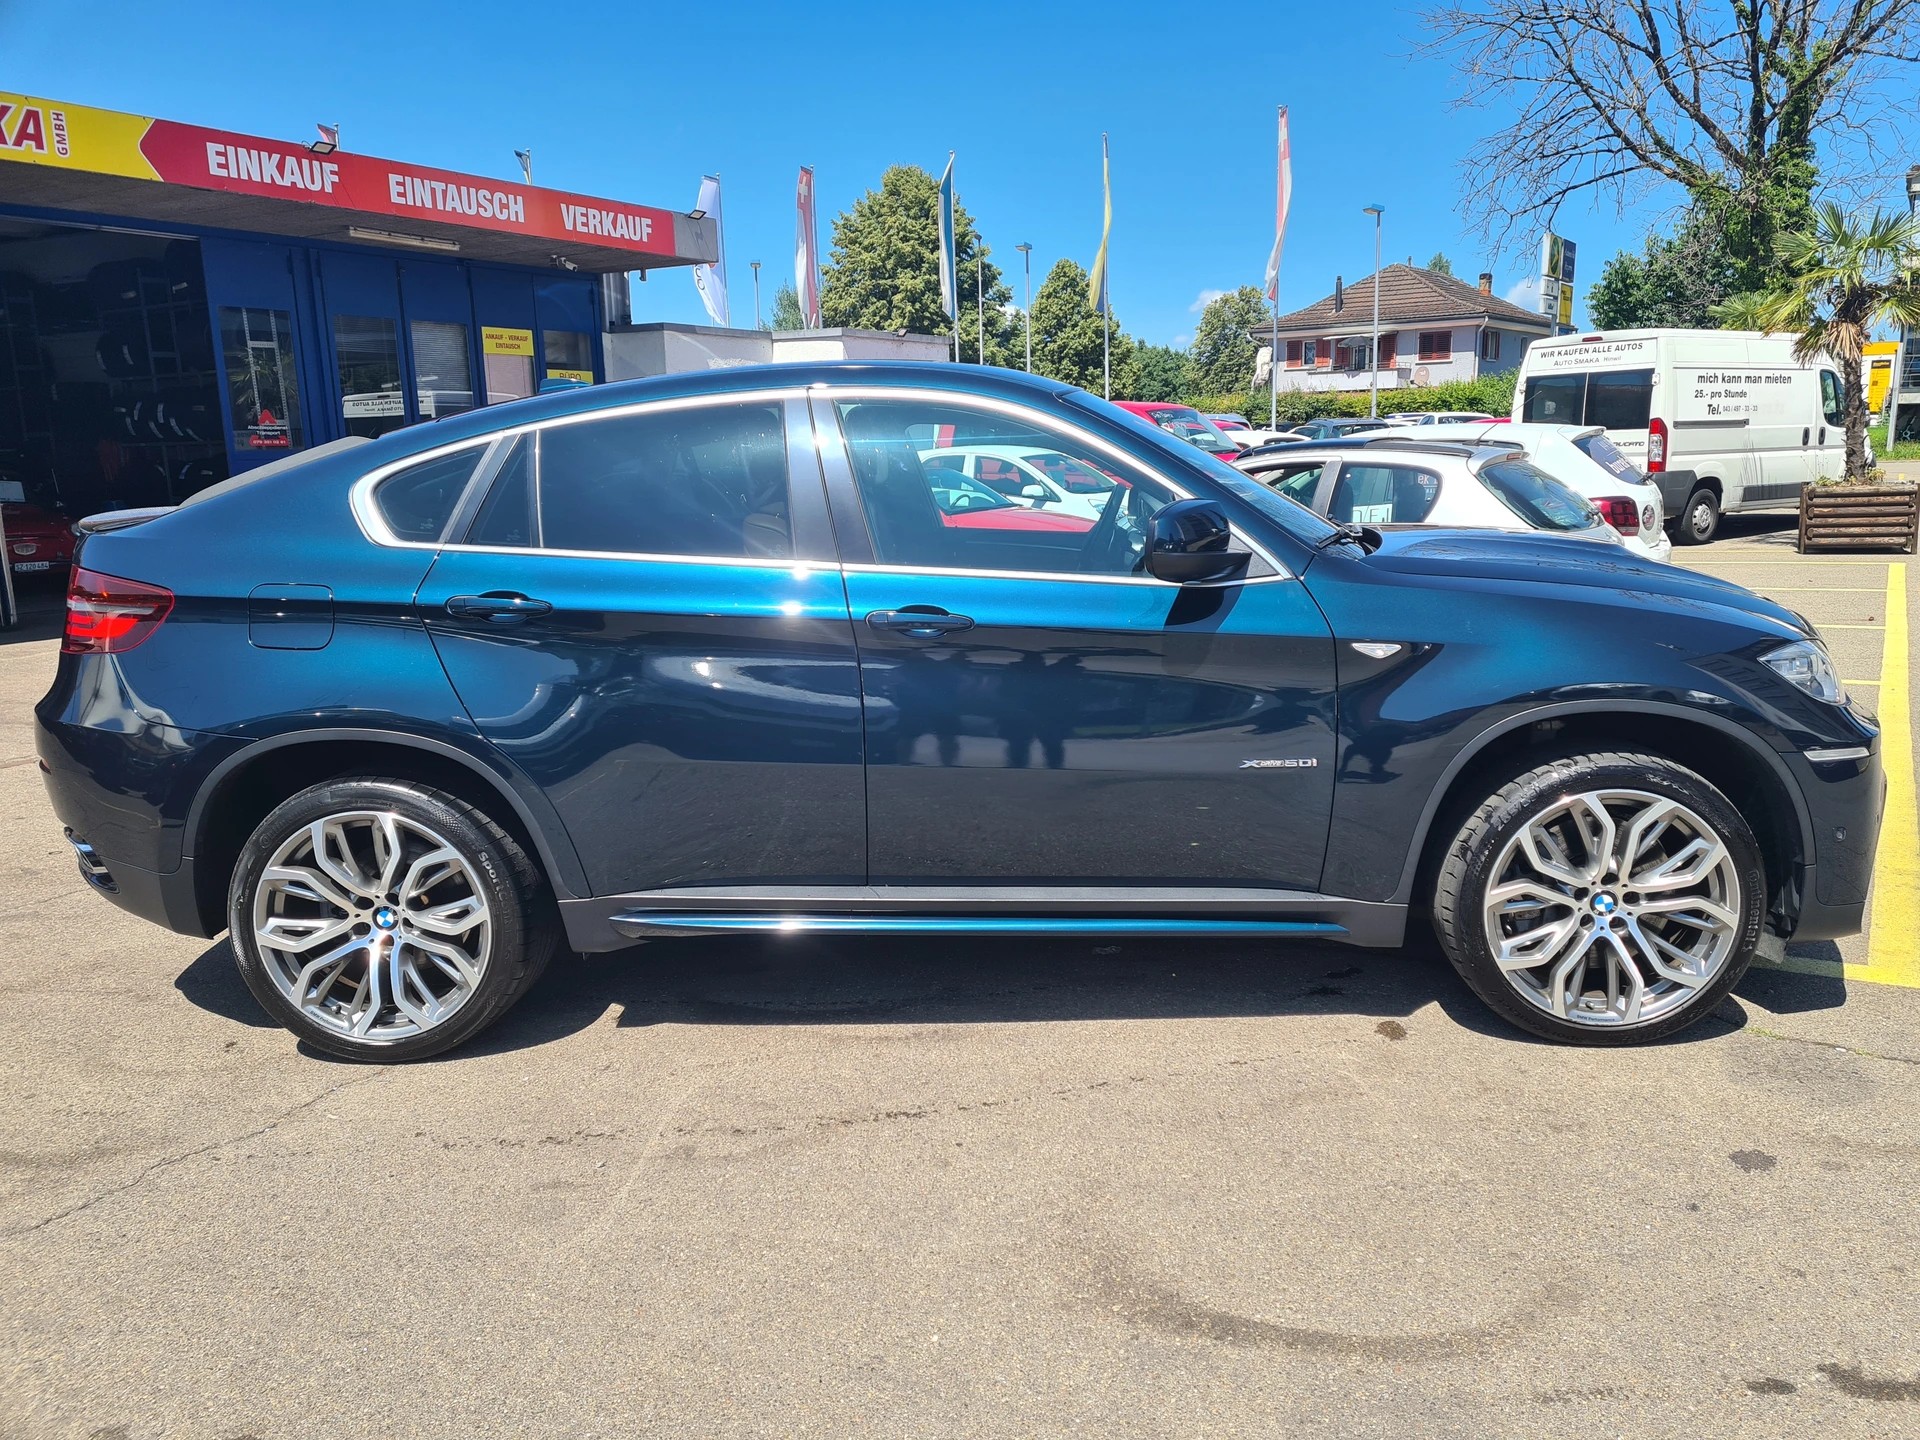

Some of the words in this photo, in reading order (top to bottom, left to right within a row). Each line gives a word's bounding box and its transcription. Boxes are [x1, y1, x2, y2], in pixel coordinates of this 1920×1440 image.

[51, 110, 70, 158] GMBH
[206, 142, 340, 194] EINKAUF
[388, 173, 525, 223] EINTAUSCH
[560, 203, 653, 243] VERKAUF
[495, 342, 521, 350] EINTAUSCH
[1557, 347, 1590, 357] KAUFEN
[1592, 346, 1612, 354] ALLE
[1614, 342, 1643, 351] AUTOS
[1697, 373, 1719, 384] mich
[1721, 373, 1742, 384] kann
[1744, 375, 1762, 384] man
[1764, 373, 1792, 384] mieten
[1694, 389, 1709, 399] 25.-
[1710, 391, 1722, 400] pro
[1724, 389, 1748, 399] Stunde
[1707, 404, 1722, 415] Tel.
